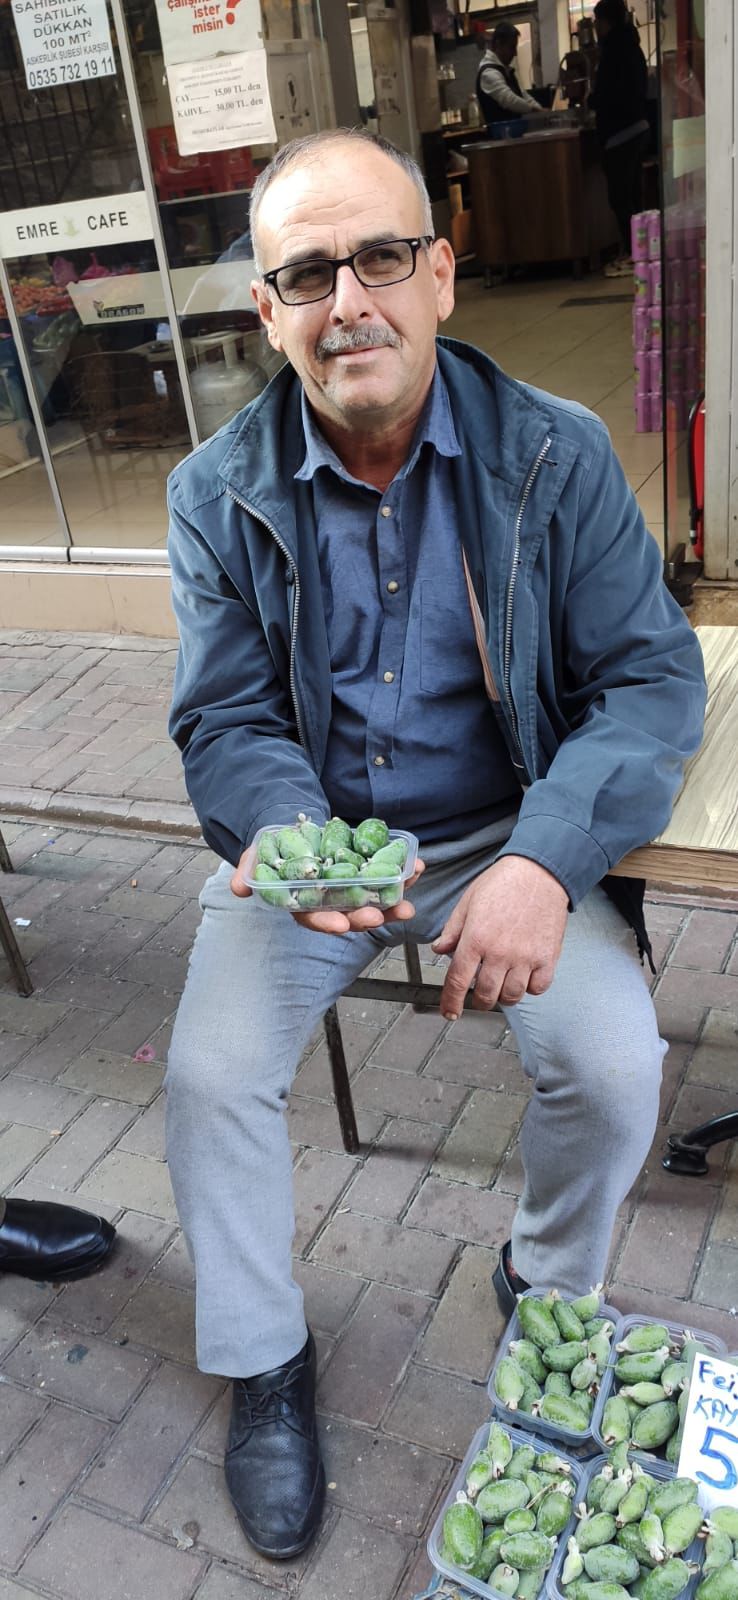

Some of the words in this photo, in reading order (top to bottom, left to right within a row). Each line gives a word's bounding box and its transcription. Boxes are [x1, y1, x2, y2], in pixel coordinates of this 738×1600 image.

[34, 4, 87, 23] SATILIK
[193, 4, 220, 19] ister
[33, 17, 92, 38] DÜKKAN
[192, 18, 223, 34] misin
[43, 37, 65, 50] 100
[29, 67, 58, 87] 0535
[60, 62, 81, 81] 732
[85, 59, 98, 76] 19
[102, 56, 114, 73] 11
[16, 221, 60, 240] EMRE
[87, 211, 129, 231] CAFE
